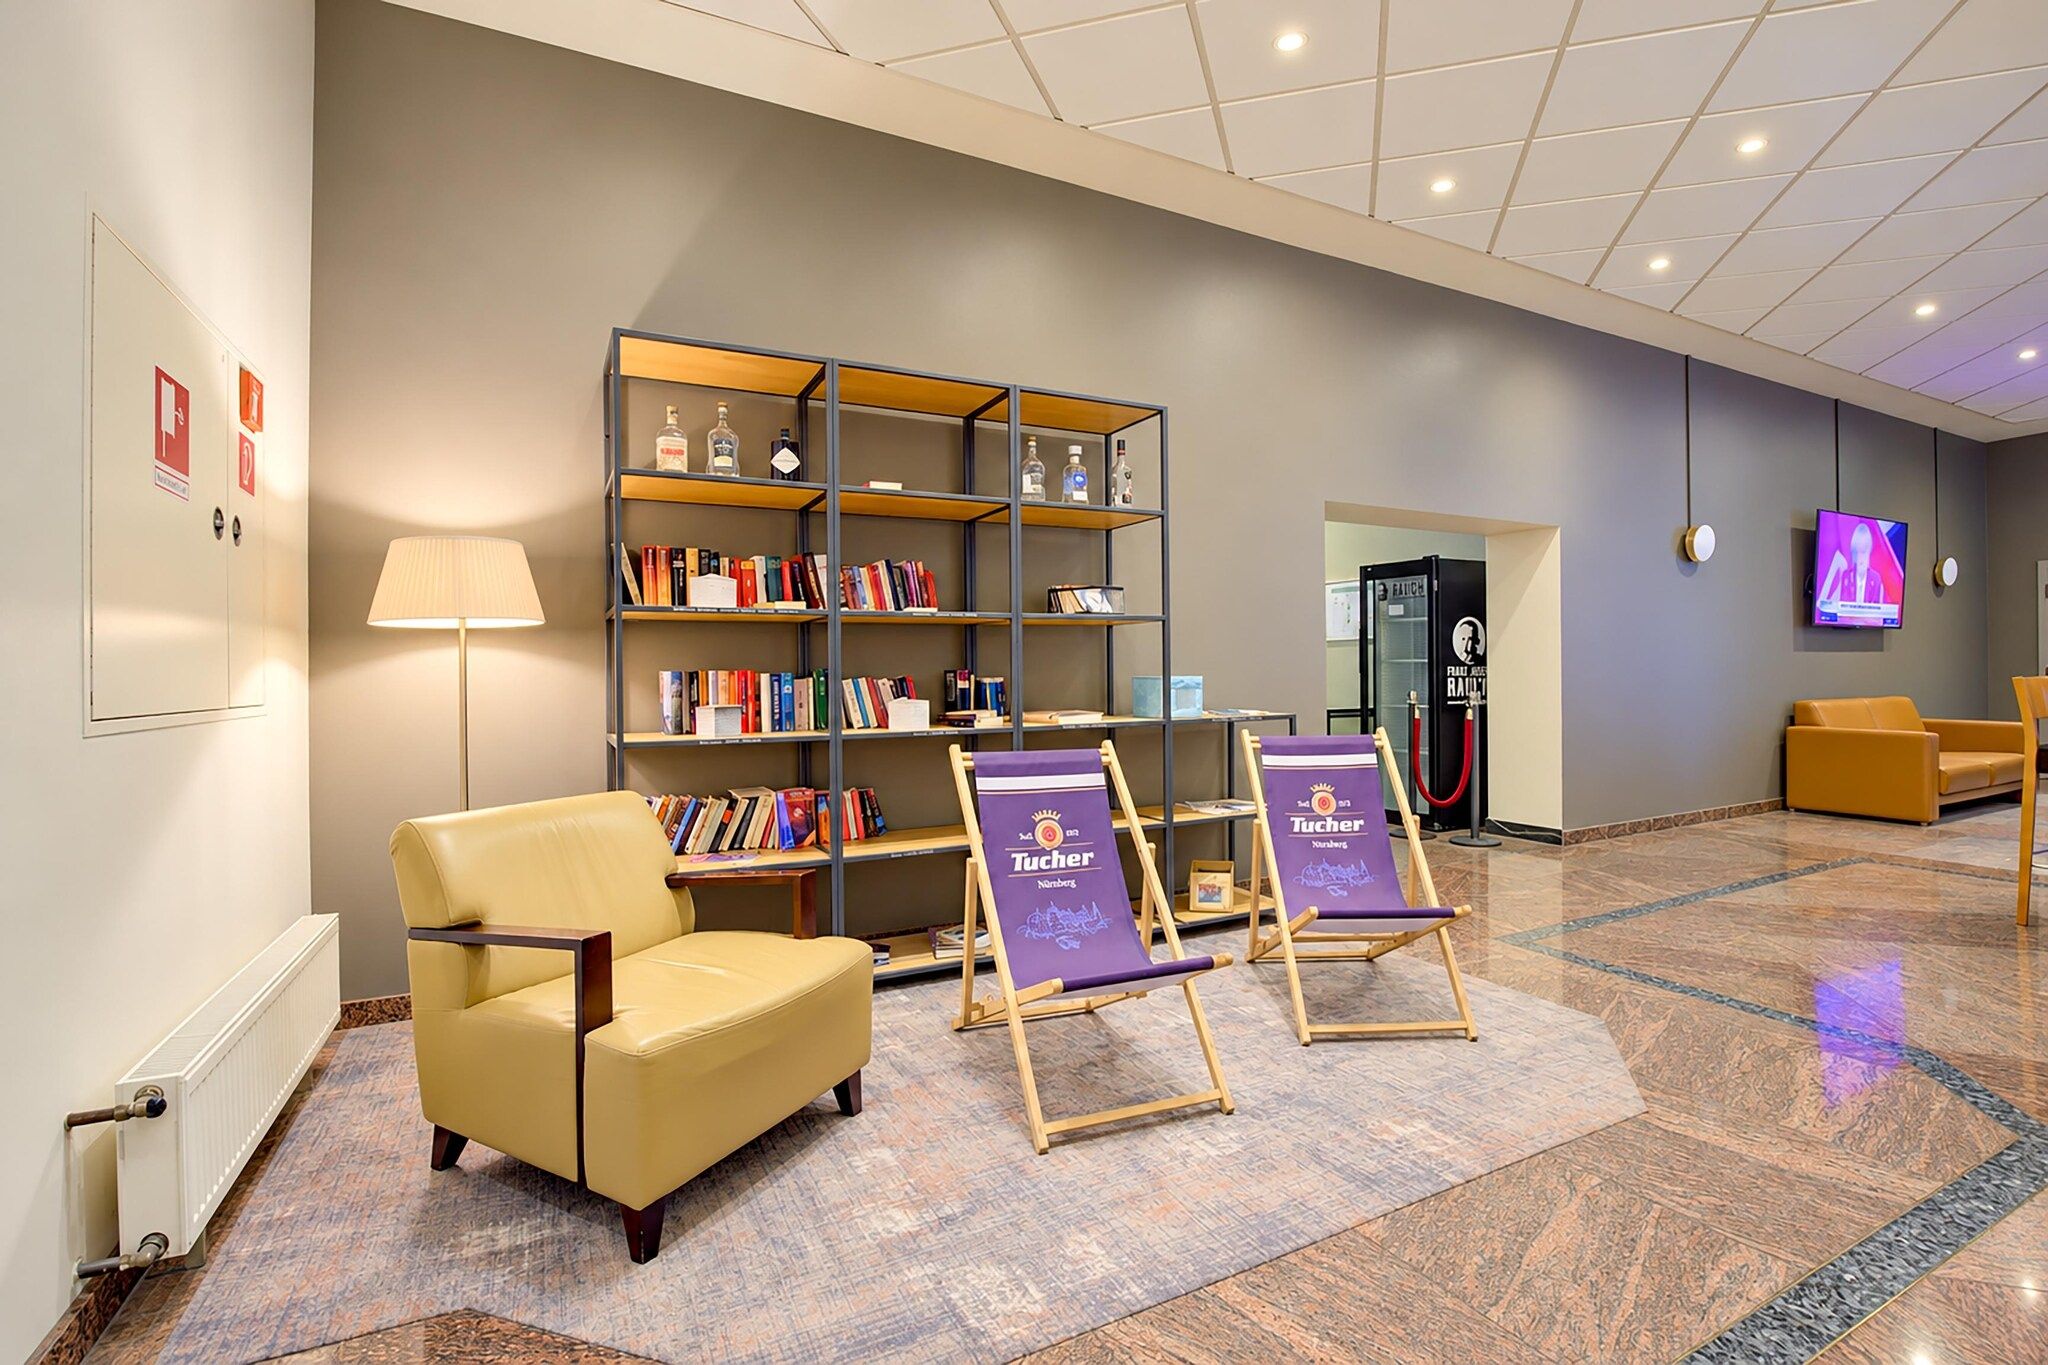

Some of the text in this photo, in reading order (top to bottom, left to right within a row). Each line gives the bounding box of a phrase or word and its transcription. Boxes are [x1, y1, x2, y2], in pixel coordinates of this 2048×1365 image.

[1290, 816, 1365, 833] Tucher
[1010, 849, 1095, 872] Tucher
[1037, 877, 1078, 890] Nürnberg
